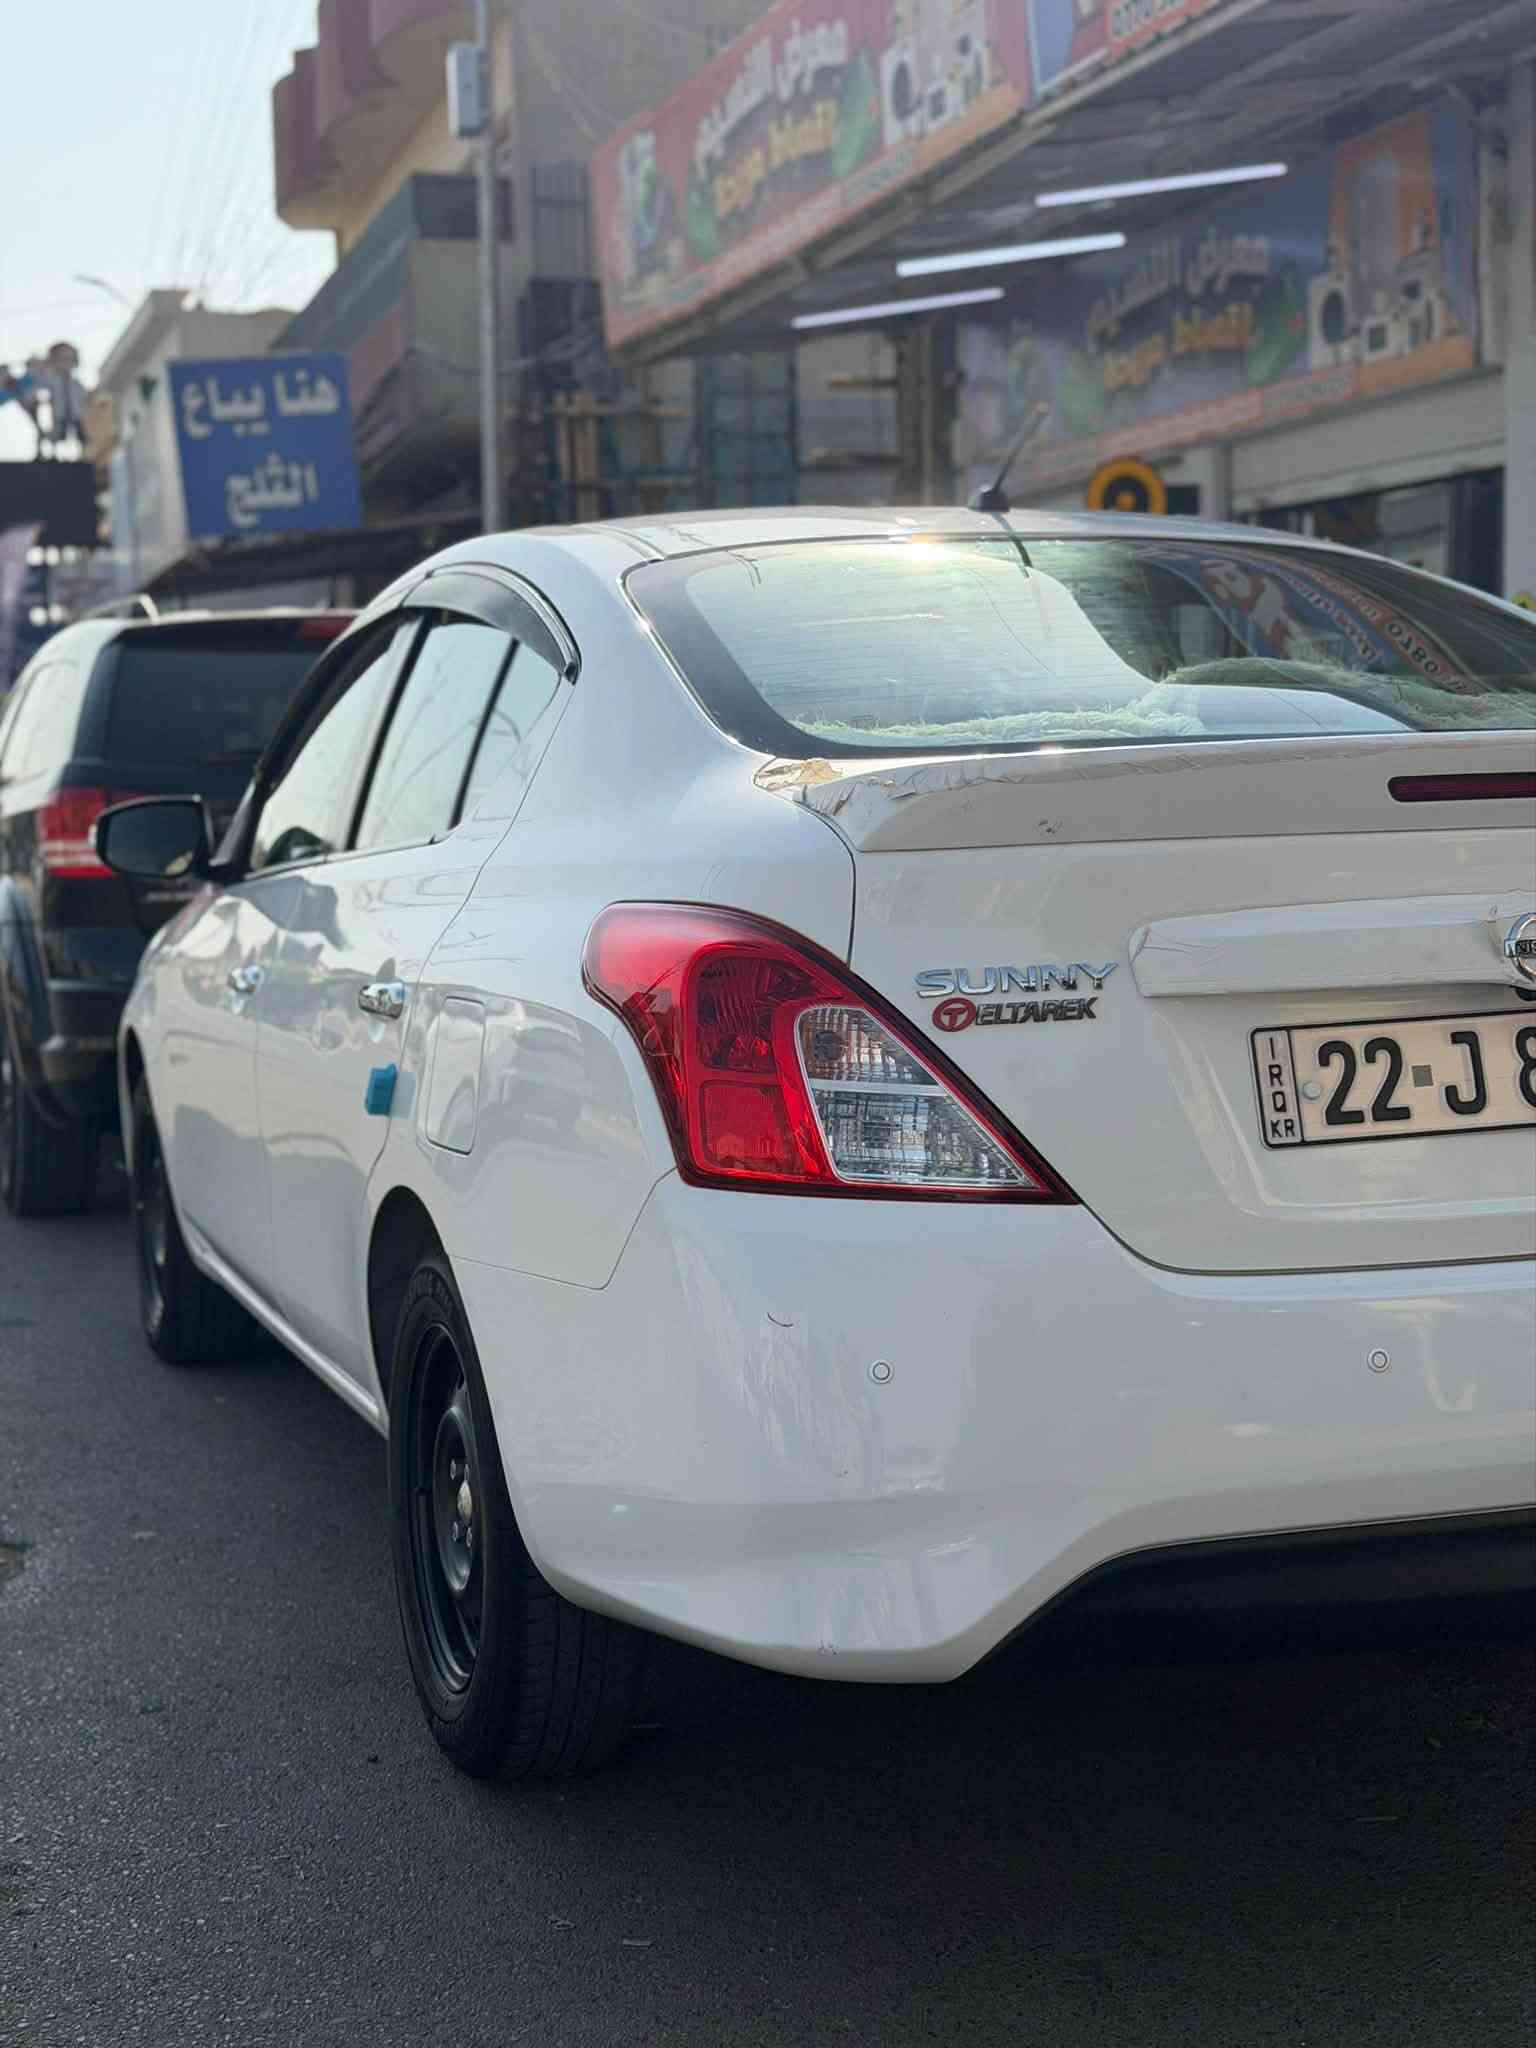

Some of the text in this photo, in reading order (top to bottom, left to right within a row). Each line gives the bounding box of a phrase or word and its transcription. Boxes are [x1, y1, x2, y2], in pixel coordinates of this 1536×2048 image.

[181, 368, 340, 440] هنا يباع
[225, 452, 319, 529] الثلج
[915, 963, 1118, 998] SUNNY
[1318, 1037, 1411, 1125] 22
[1445, 1031, 1486, 1115] J
[1270, 1118, 1295, 1138] KR
